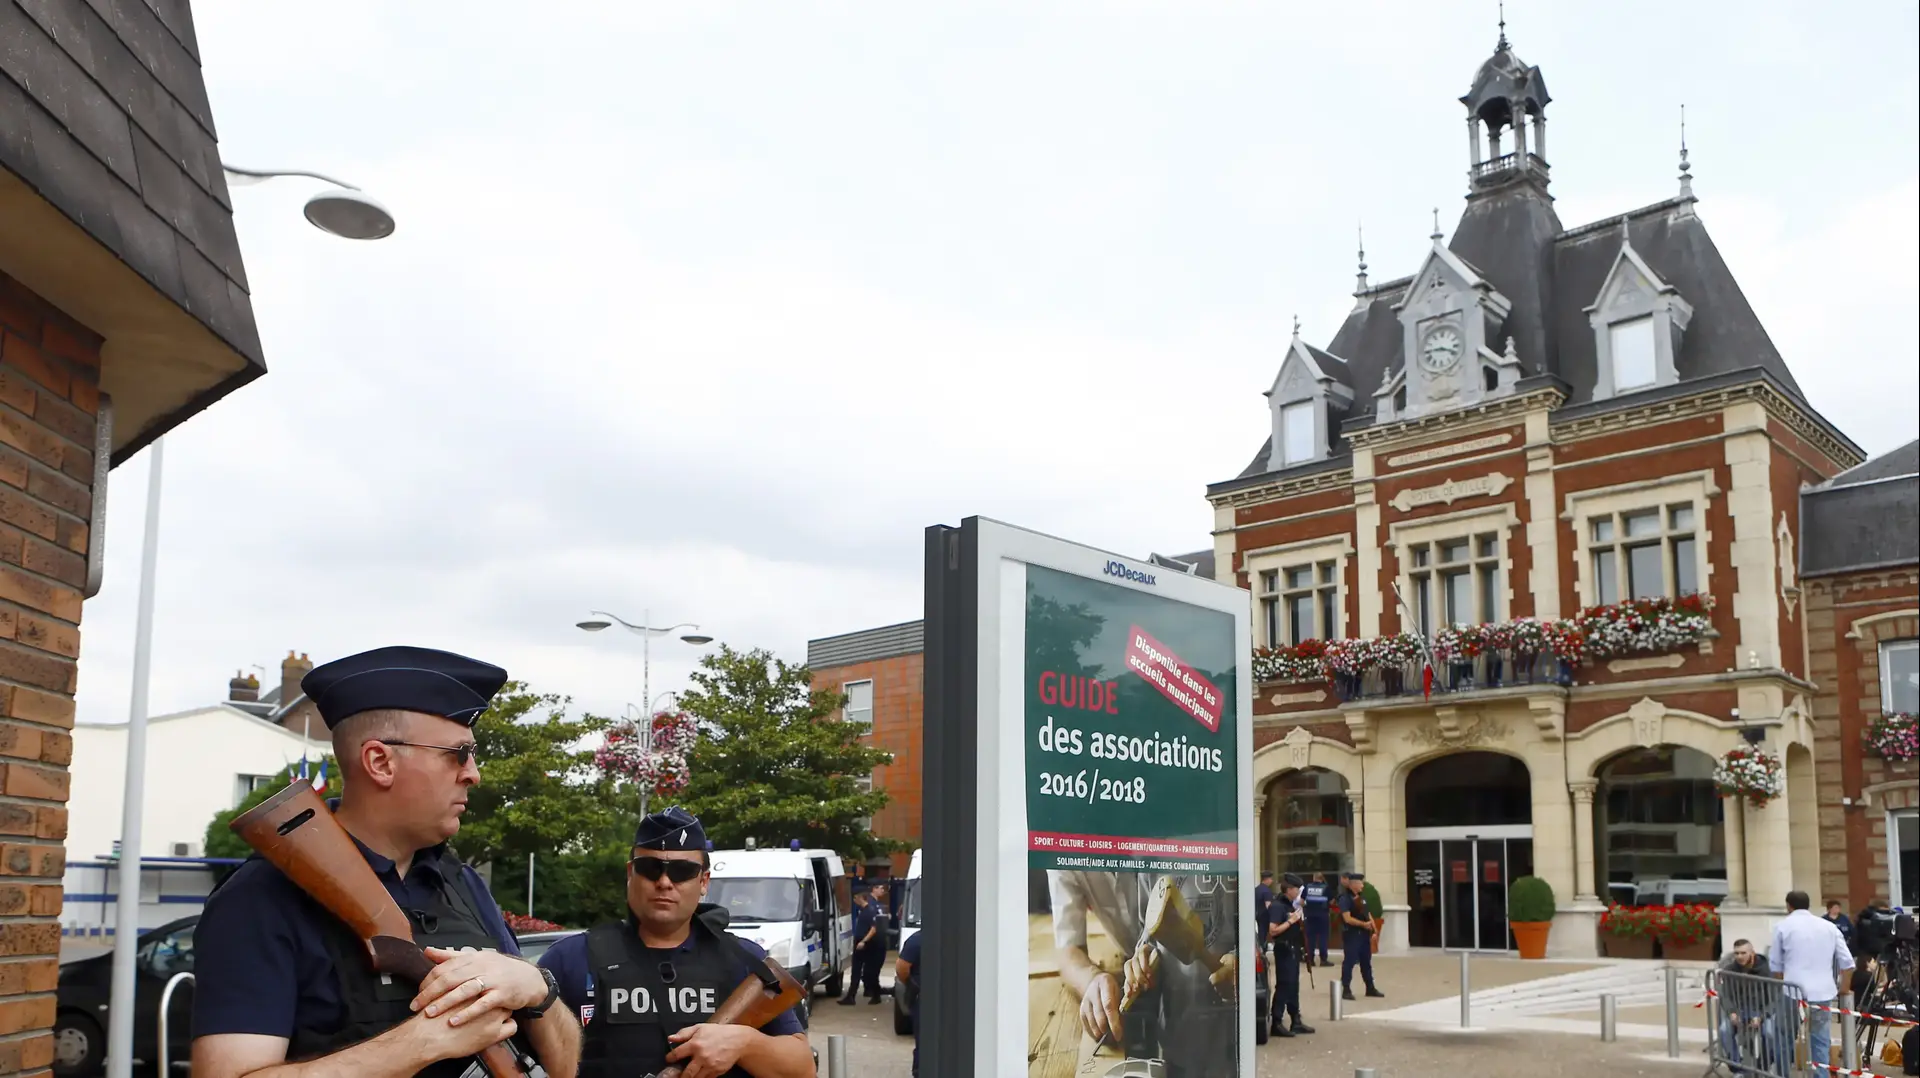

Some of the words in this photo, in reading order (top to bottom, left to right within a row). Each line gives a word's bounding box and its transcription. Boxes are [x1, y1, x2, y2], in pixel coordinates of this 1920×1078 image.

[1103, 560, 1156, 585] JCDecaux
[1135, 634, 1182, 679] Disponible
[1182, 672, 1203, 696] dans
[1203, 687, 1216, 706] les
[1038, 671, 1118, 714] GUIDE
[1130, 655, 1167, 688] accueils
[1166, 682, 1214, 725] municipaux
[1038, 716, 1083, 755] des
[1090, 731, 1223, 772] associations
[1639, 720, 1658, 739] RF
[1039, 769, 1146, 805] 2016/2018
[1034, 836, 1054, 846] SPORT
[1059, 838, 1085, 848] CULTURE
[1088, 840, 1112, 849] LOISIRS
[1117, 842, 1178, 853] LOGEMENT/QUARTIERS
[1182, 845, 1204, 854] PARENTS
[1057, 856, 1105, 868] SOLIDARITÉ/AIDE
[1119, 860, 1145, 869] FAMILLES
[1149, 861, 1173, 869] ANCIENS
[1173, 862, 1210, 871] COMBATTANTS
[611, 987, 716, 1014] POICE
